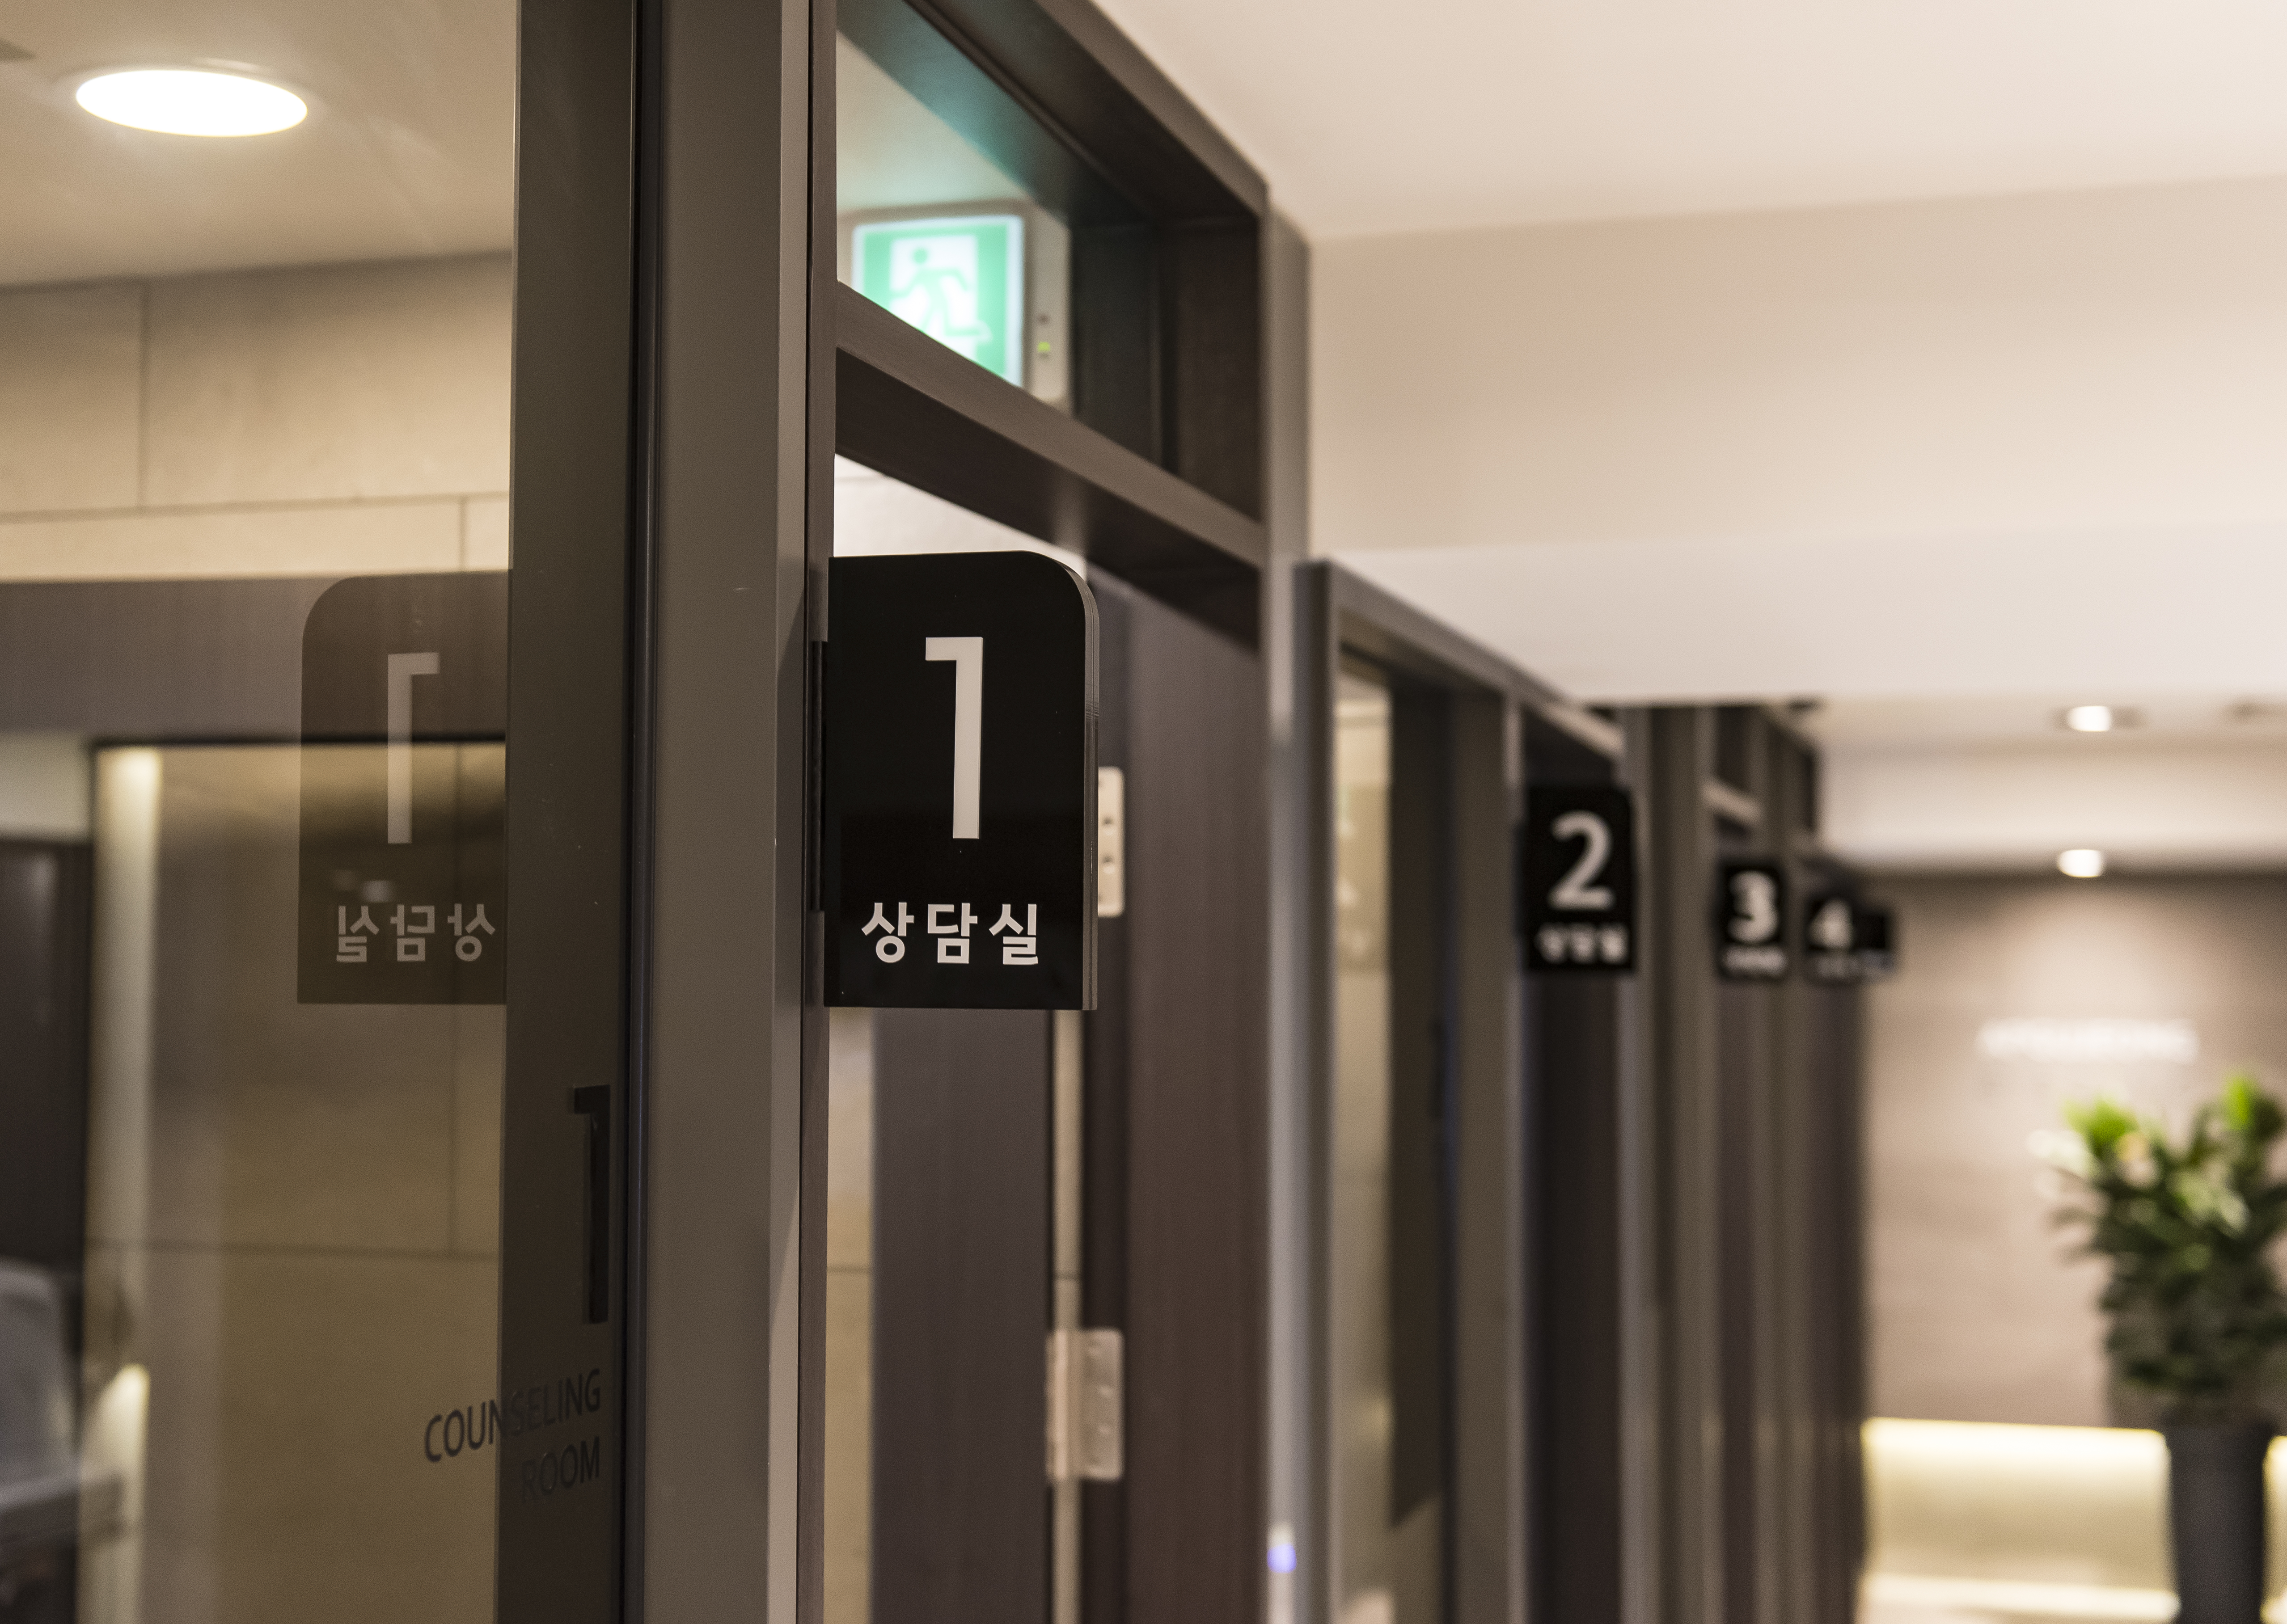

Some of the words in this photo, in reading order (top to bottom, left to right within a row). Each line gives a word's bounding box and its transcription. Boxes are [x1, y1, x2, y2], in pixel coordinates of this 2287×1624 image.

[926, 637, 983, 839] 1
[1550, 810, 1613, 910] 2
[861, 902, 1038, 965] 상담실
[1729, 871, 1777, 943] 3
[1808, 899, 1852, 949] 4
[572, 1084, 610, 1324] 1
[425, 1368, 600, 1462] COUNSELING
[521, 1436, 600, 1503] ROOM
